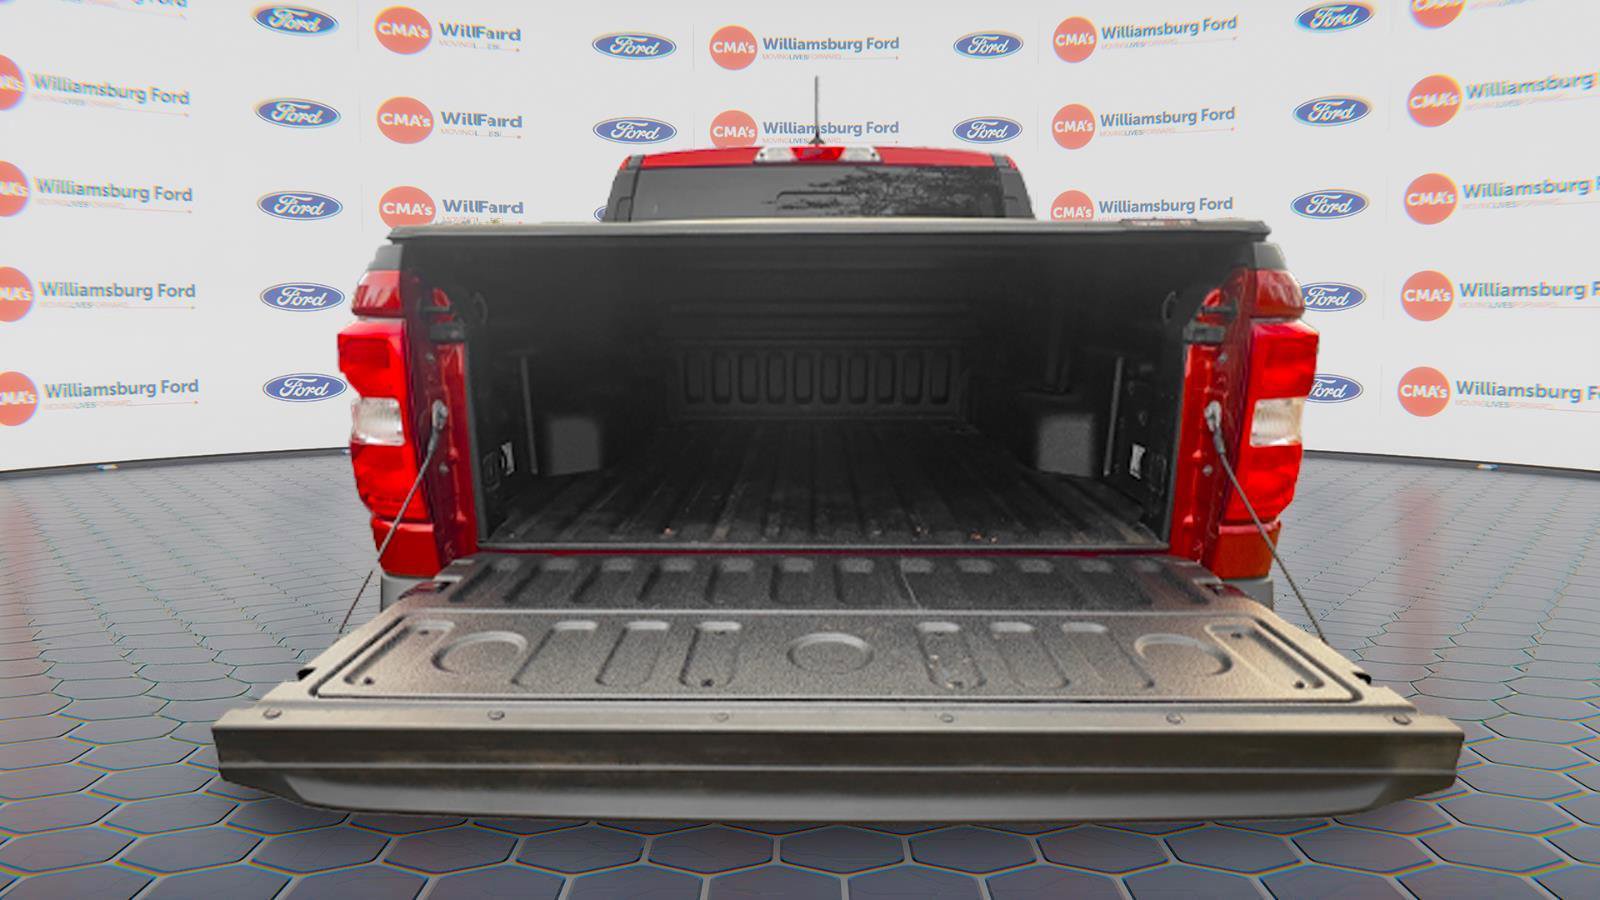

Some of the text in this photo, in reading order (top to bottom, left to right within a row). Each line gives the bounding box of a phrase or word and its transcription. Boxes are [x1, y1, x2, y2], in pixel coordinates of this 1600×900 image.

[268, 8, 321, 32] Ford
[1101, 15, 1238, 40] Williamsburg Ford
[1310, 6, 1359, 30] Ford
[610, 36, 660, 56] Ford
[712, 41, 755, 54] CMA's
[762, 36, 900, 54] Williamsburg Ford
[967, 35, 1009, 55] Ford
[1055, 31, 1095, 47] CMA's
[33, 75, 147, 105] Williamsburg
[151, 87, 190, 105] Ford
[1466, 73, 1594, 100] Williamsburg
[271, 100, 323, 124] Ford
[380, 112, 431, 128] CMA's
[1099, 106, 1236, 127] Williamsburg Ford
[1308, 100, 1356, 122] Ford
[610, 122, 660, 140] Ford
[712, 125, 756, 139] CMA's
[762, 120, 900, 138] Williamsburg Ford
[968, 121, 1008, 140] Ford
[1054, 119, 1094, 133] CMA's
[36, 178, 150, 204] Williamsburg
[154, 185, 193, 202] Ford
[1462, 179, 1590, 199] Williamsburg
[274, 195, 325, 216] Ford
[382, 201, 433, 216] CMA's
[1052, 206, 1092, 219] CMA's
[1098, 196, 1234, 214] Williamsburg Ford
[1305, 194, 1352, 214] Ford
[40, 281, 196, 301] Williamsburg Ford
[276, 287, 328, 307] Ford
[1304, 287, 1349, 306] Ford
[1403, 289, 1451, 303] CMA's
[1459, 281, 1586, 300] Williamsburg
[44, 378, 199, 398] Williamsburg Ford
[279, 378, 329, 397] Ford
[1400, 384, 1448, 399] CMA's
[1455, 380, 1582, 404] Williamsburg
